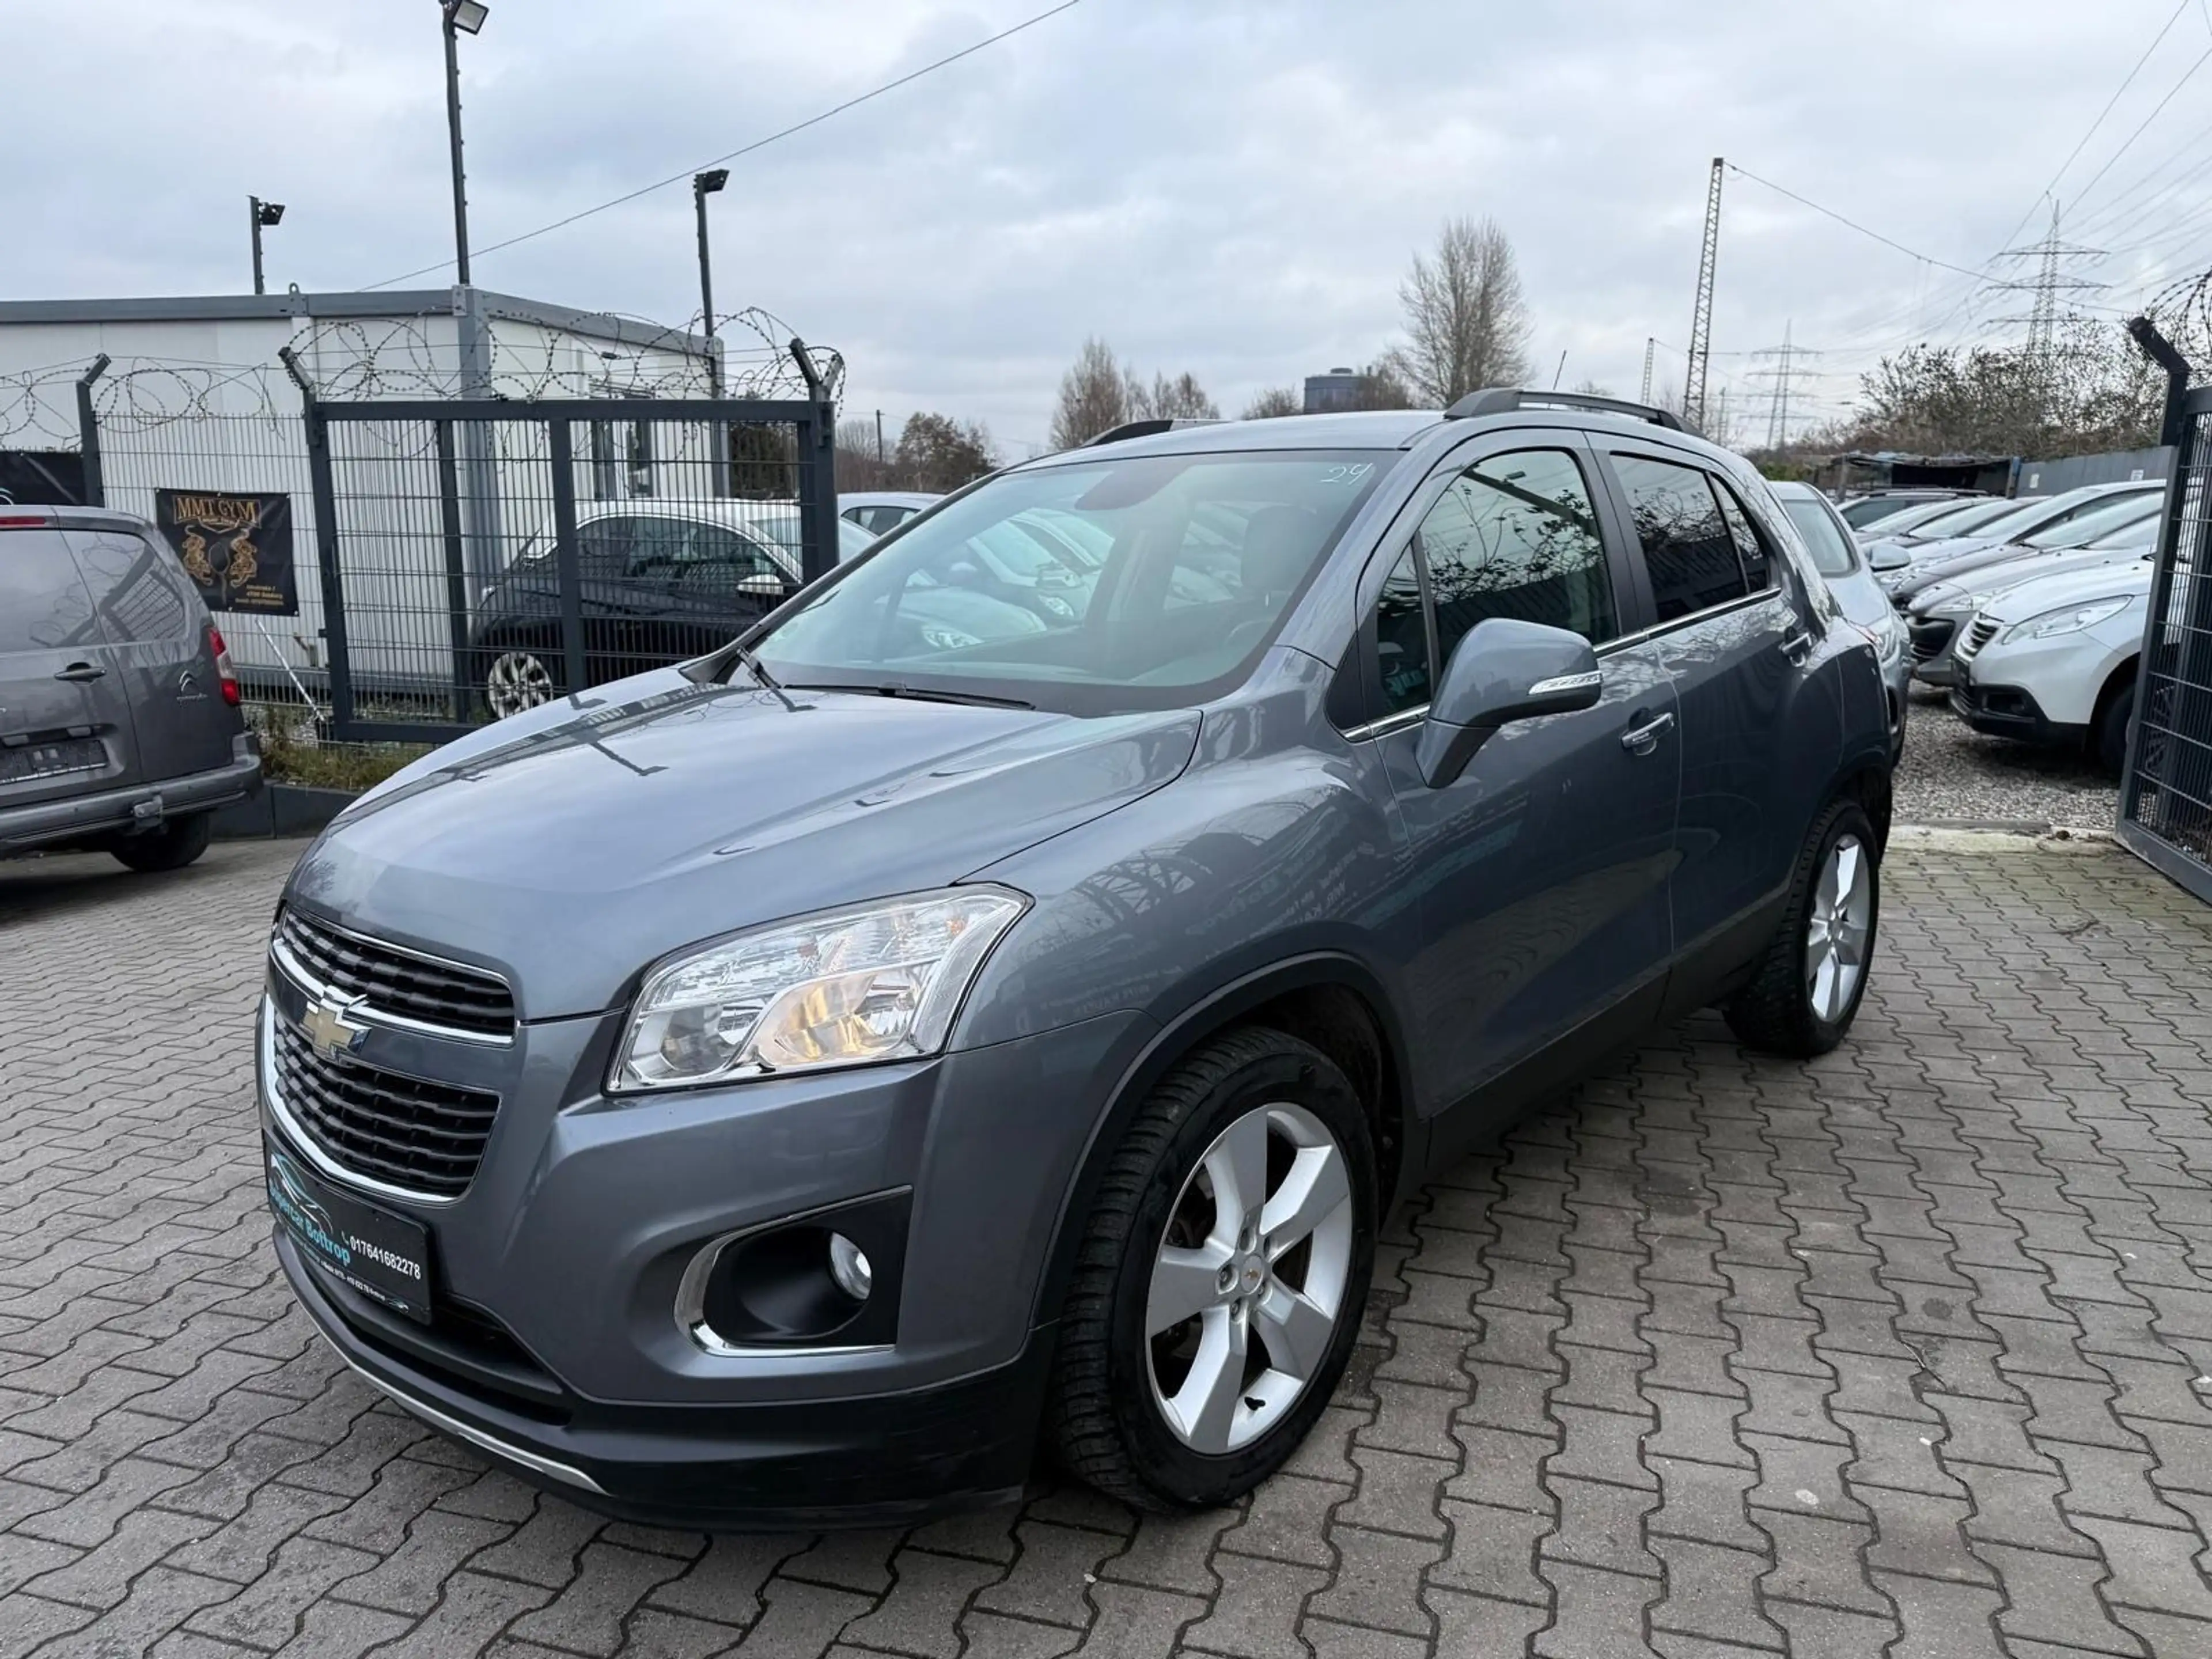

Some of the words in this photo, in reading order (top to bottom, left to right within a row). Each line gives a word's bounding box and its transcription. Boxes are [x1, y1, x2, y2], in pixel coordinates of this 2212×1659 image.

[177, 497, 214, 519] MMT
[218, 499, 256, 523] GYM
[305, 1218, 351, 1266] Bottrop
[350, 1236, 421, 1280] 017641682278
